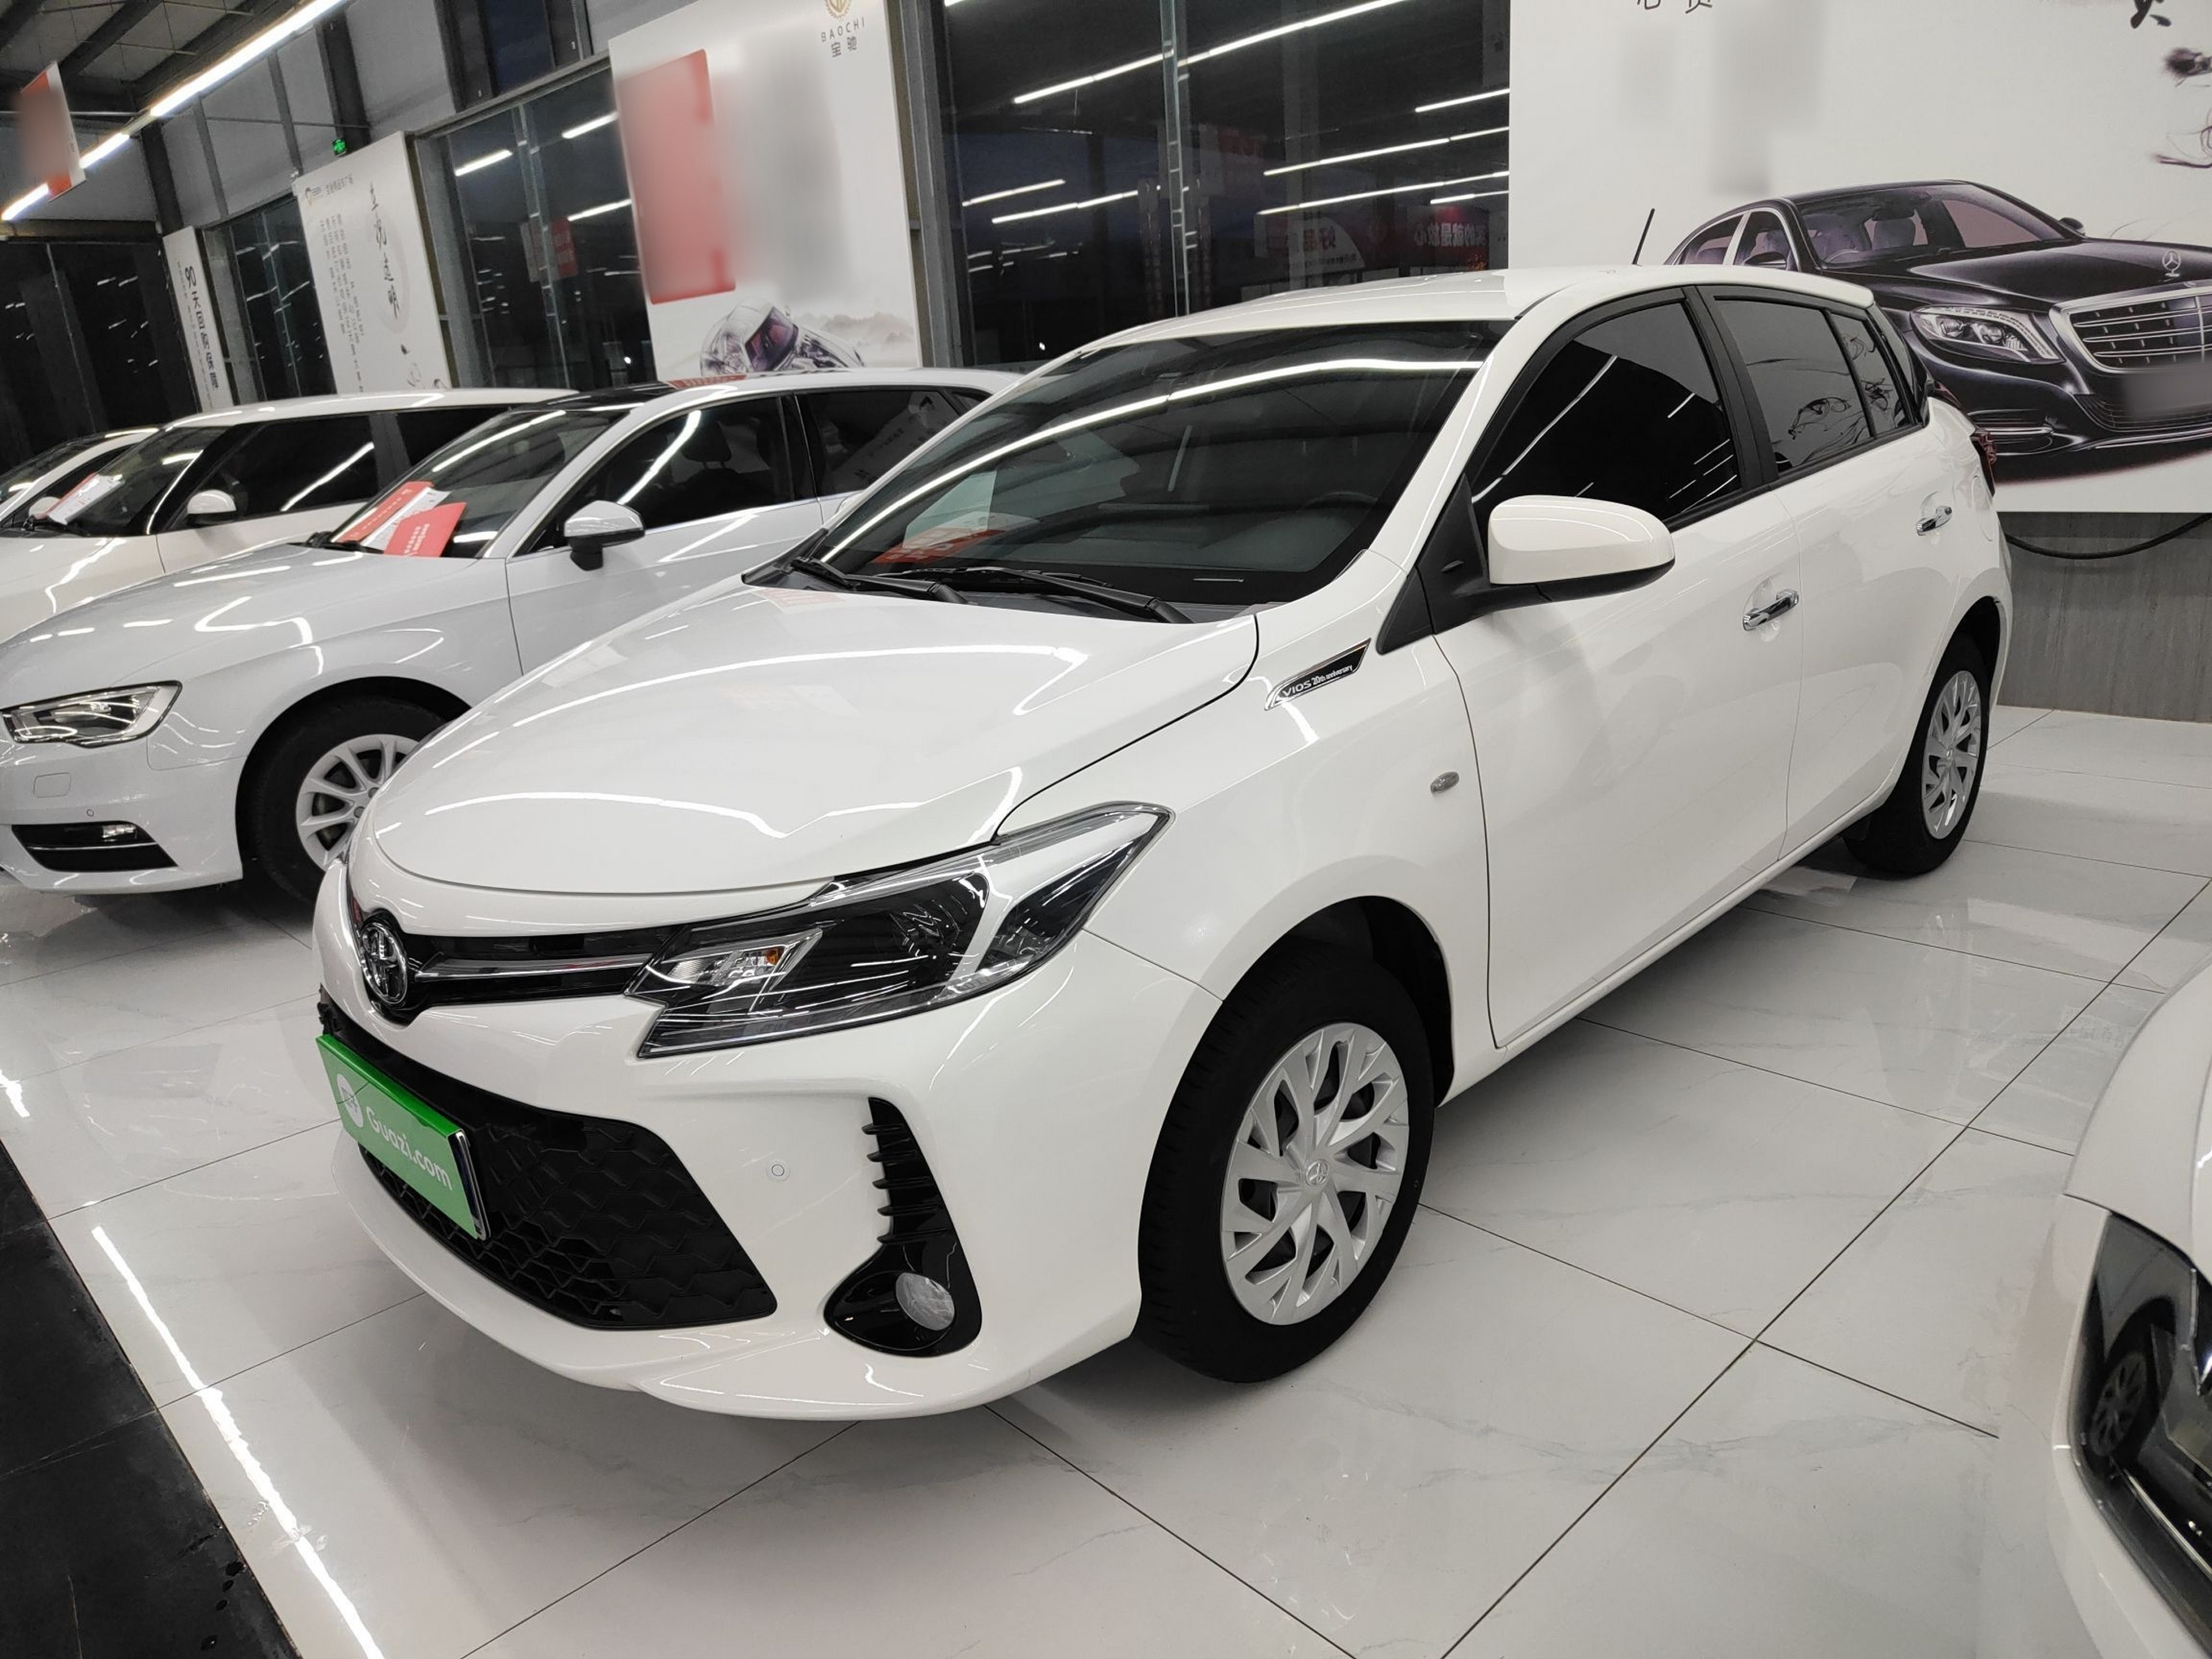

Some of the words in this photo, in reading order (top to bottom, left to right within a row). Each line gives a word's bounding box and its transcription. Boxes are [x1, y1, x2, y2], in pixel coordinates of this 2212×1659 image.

[821, 17, 865, 43] BAOCHI
[831, 36, 857, 58] 宝驰
[1282, 680, 1312, 696] VIOS
[1311, 675, 1327, 685] 20th
[1325, 665, 1353, 680] anniversary
[366, 1105, 453, 1191] Guazi.com
